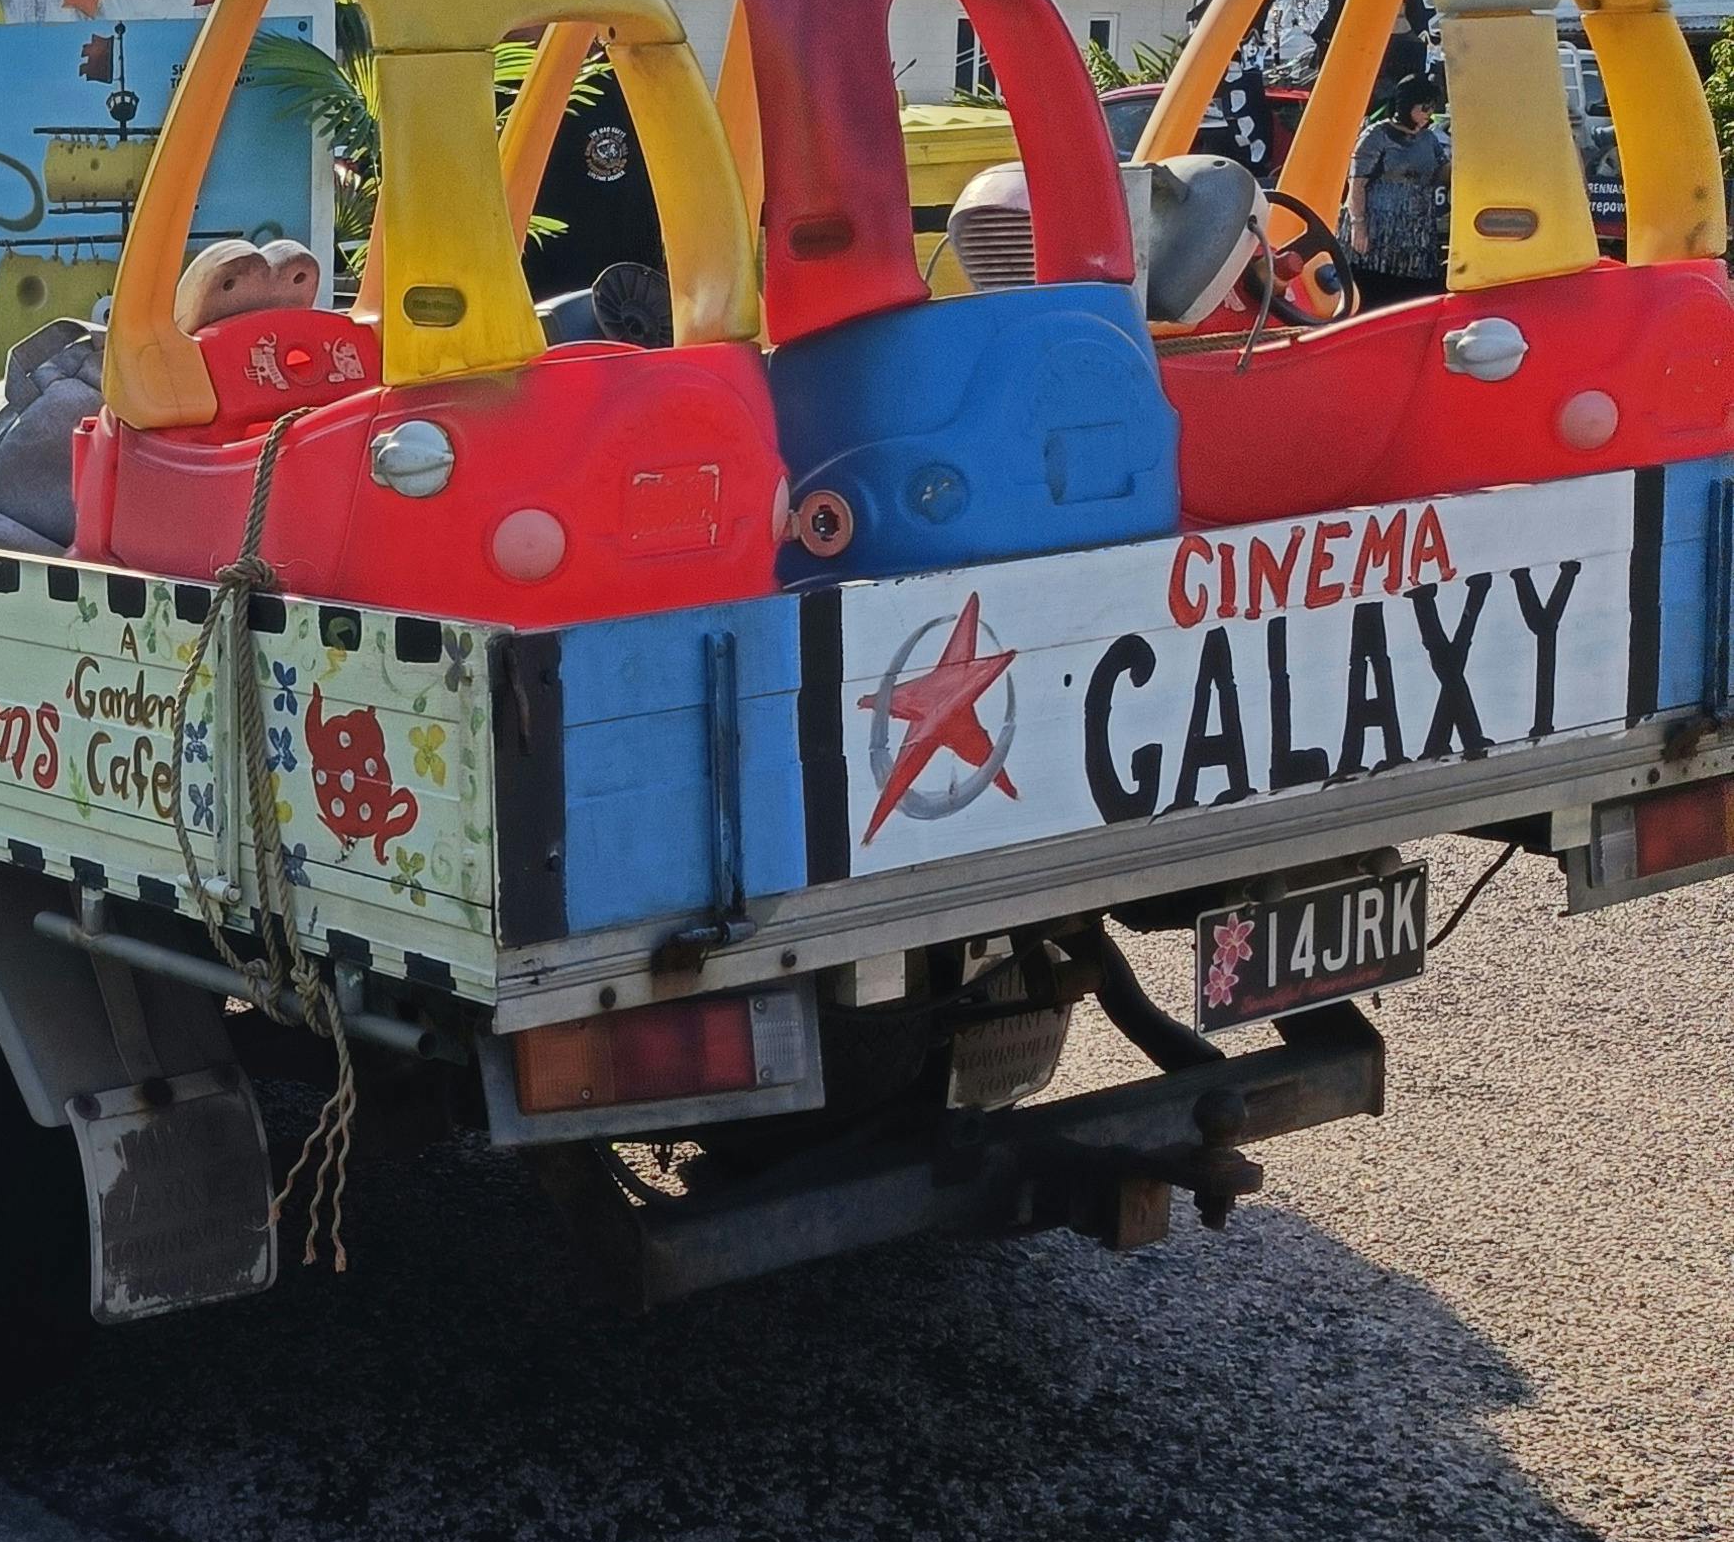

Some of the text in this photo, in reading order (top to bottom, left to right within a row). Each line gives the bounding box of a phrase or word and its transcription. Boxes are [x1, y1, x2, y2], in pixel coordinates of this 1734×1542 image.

[1168, 503, 1458, 628] CINEMA
[119, 622, 140, 663] A
[1084, 560, 1583, 825] GALAXY
